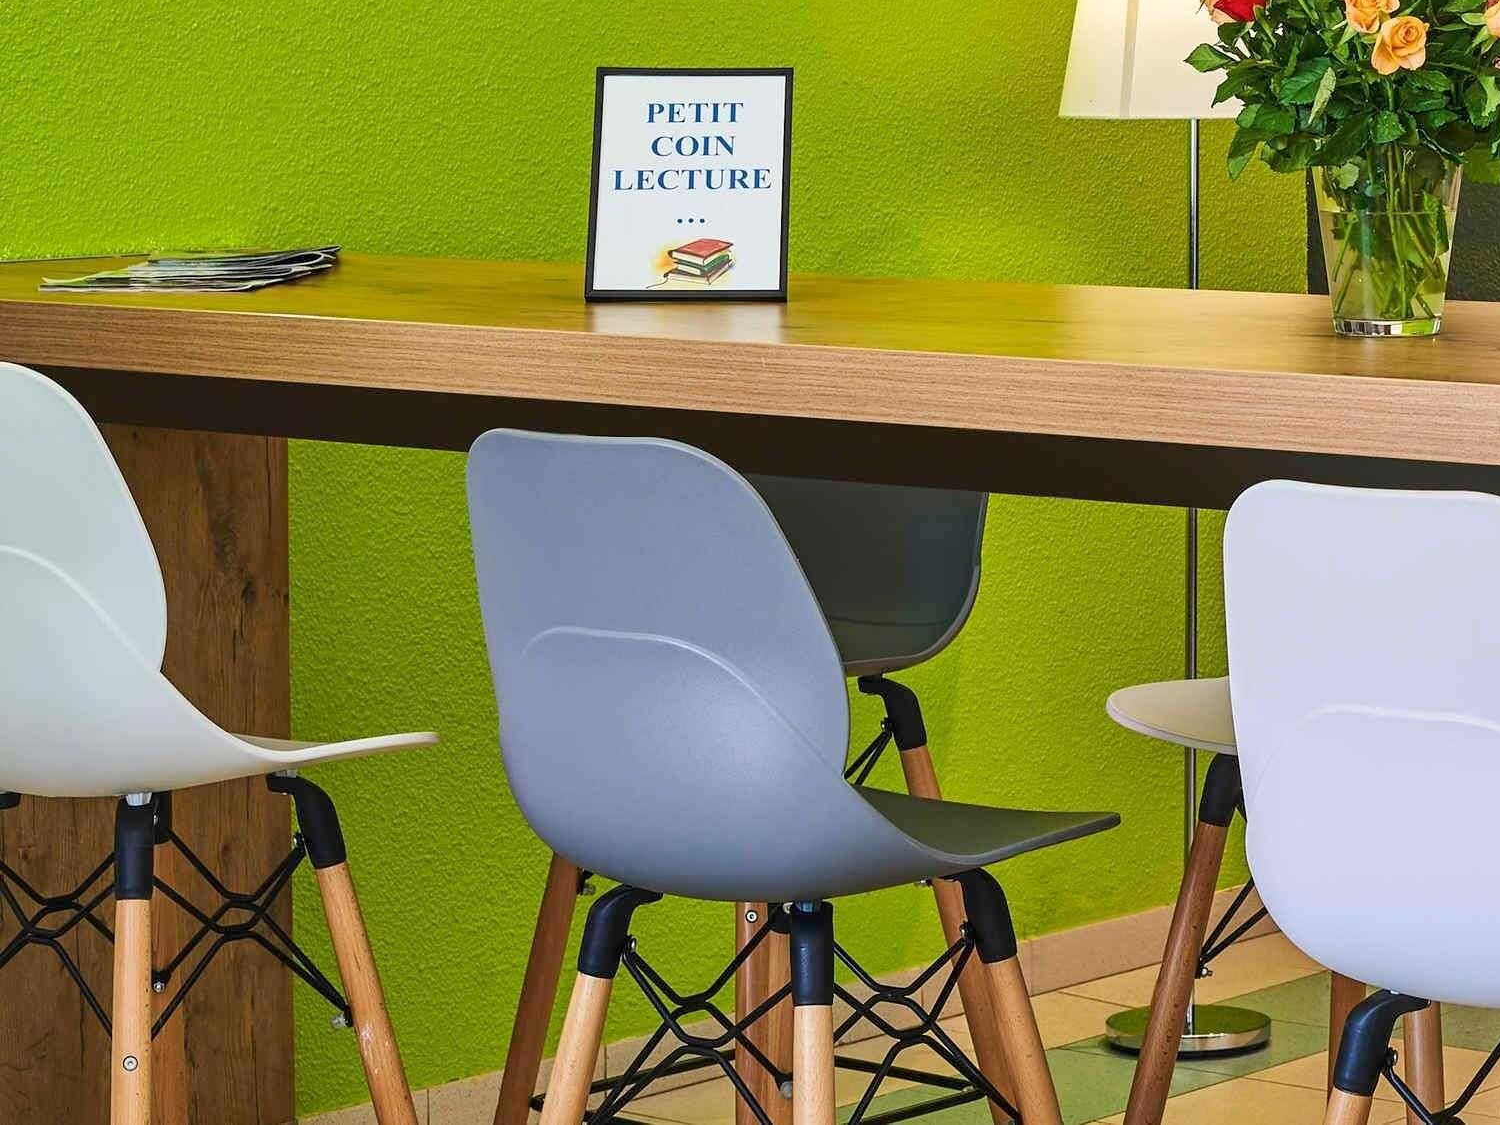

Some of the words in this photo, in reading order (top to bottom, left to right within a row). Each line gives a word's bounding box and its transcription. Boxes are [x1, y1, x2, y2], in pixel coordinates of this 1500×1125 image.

[647, 102, 744, 123] PETIT
[651, 135, 736, 157] COIN
[612, 168, 772, 191] LECTURE
